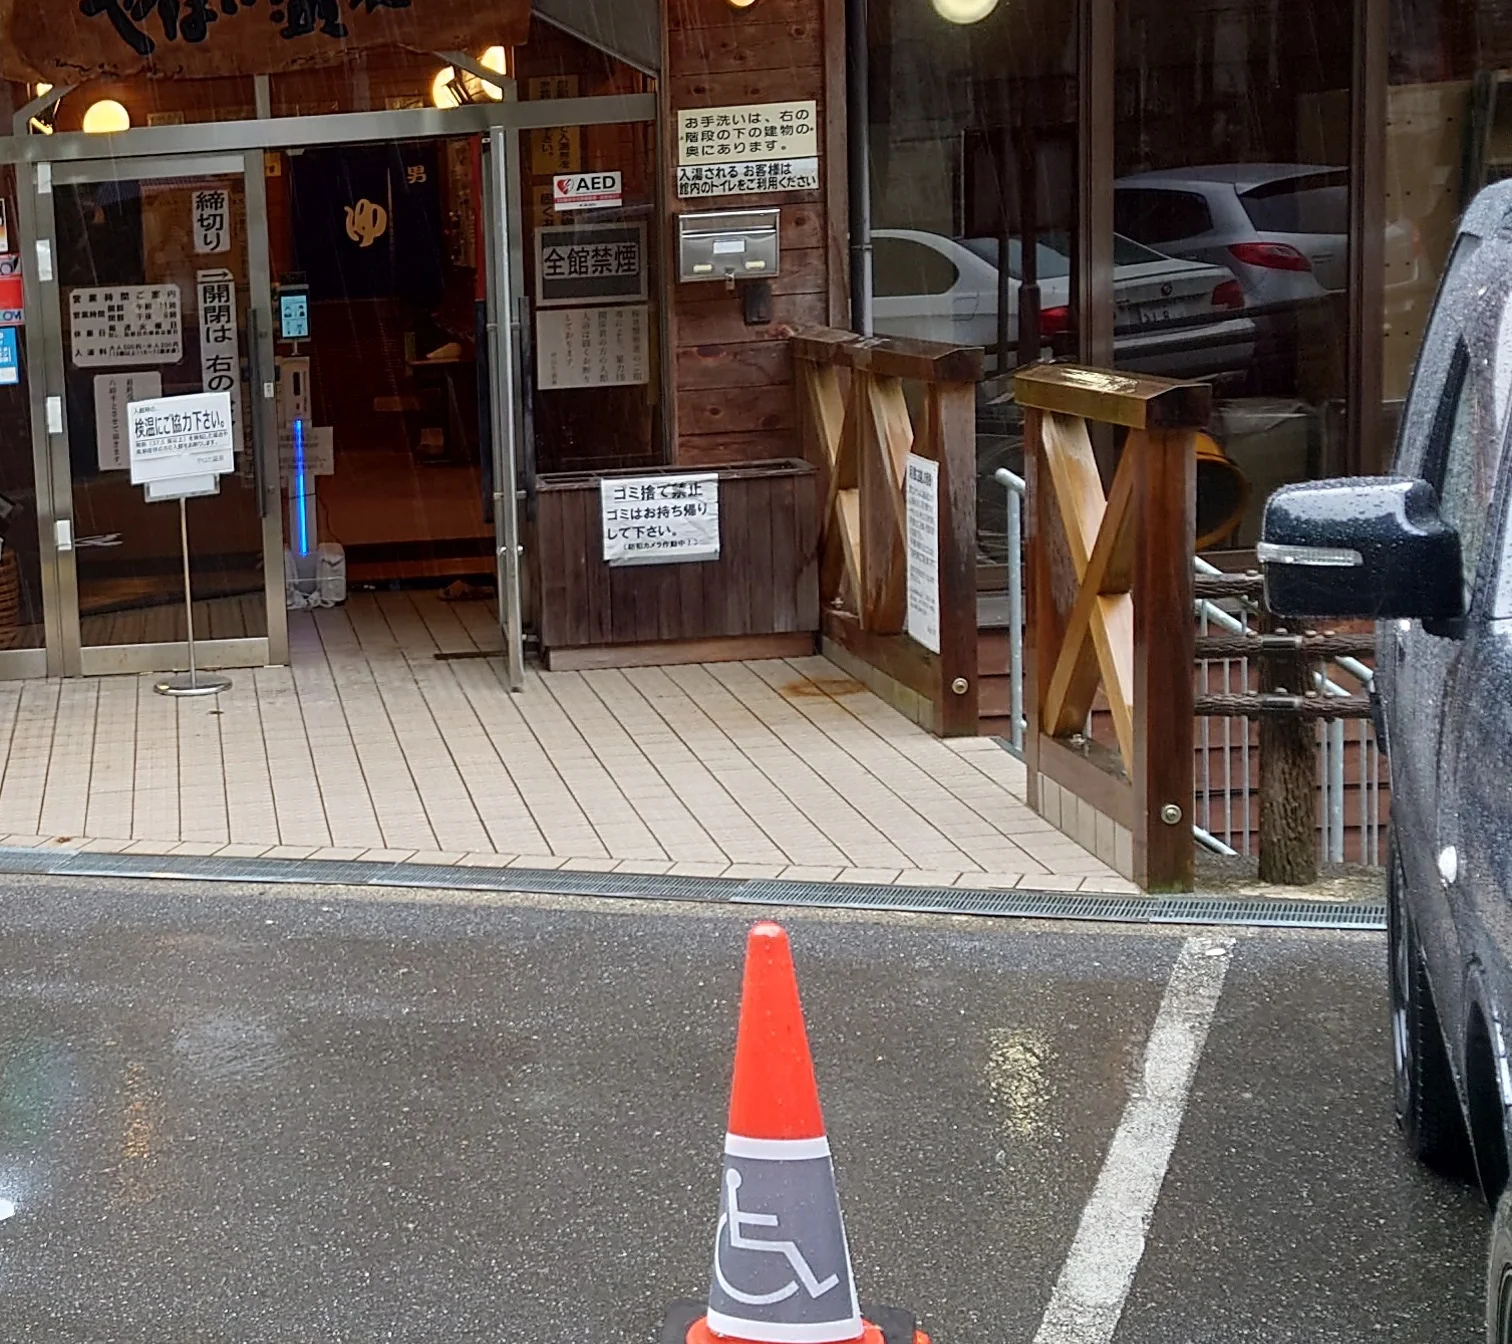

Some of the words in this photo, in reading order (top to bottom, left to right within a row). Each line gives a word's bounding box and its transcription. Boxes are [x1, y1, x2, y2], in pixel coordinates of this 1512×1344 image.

[685, 109, 809, 129] お手洗いは、右の
[685, 124, 810, 143] 階段の下の建物の
[686, 140, 787, 158] 奥にあります。
[407, 165, 426, 184] 男
[744, 163, 792, 177] お客様は
[577, 176, 615, 191] AED
[195, 191, 225, 252] 締切り
[345, 198, 387, 248] ゆ
[544, 244, 637, 277] 全館禁煙
[203, 285, 232, 343] 開閉は
[206, 355, 234, 411] 右の
[135, 410, 224, 438] 検温にご協力下さい。
[614, 482, 703, 501] ゴミ捨て禁止
[607, 503, 707, 521] ゴミはお持ち帰り
[608, 525, 677, 540] して下さい。
